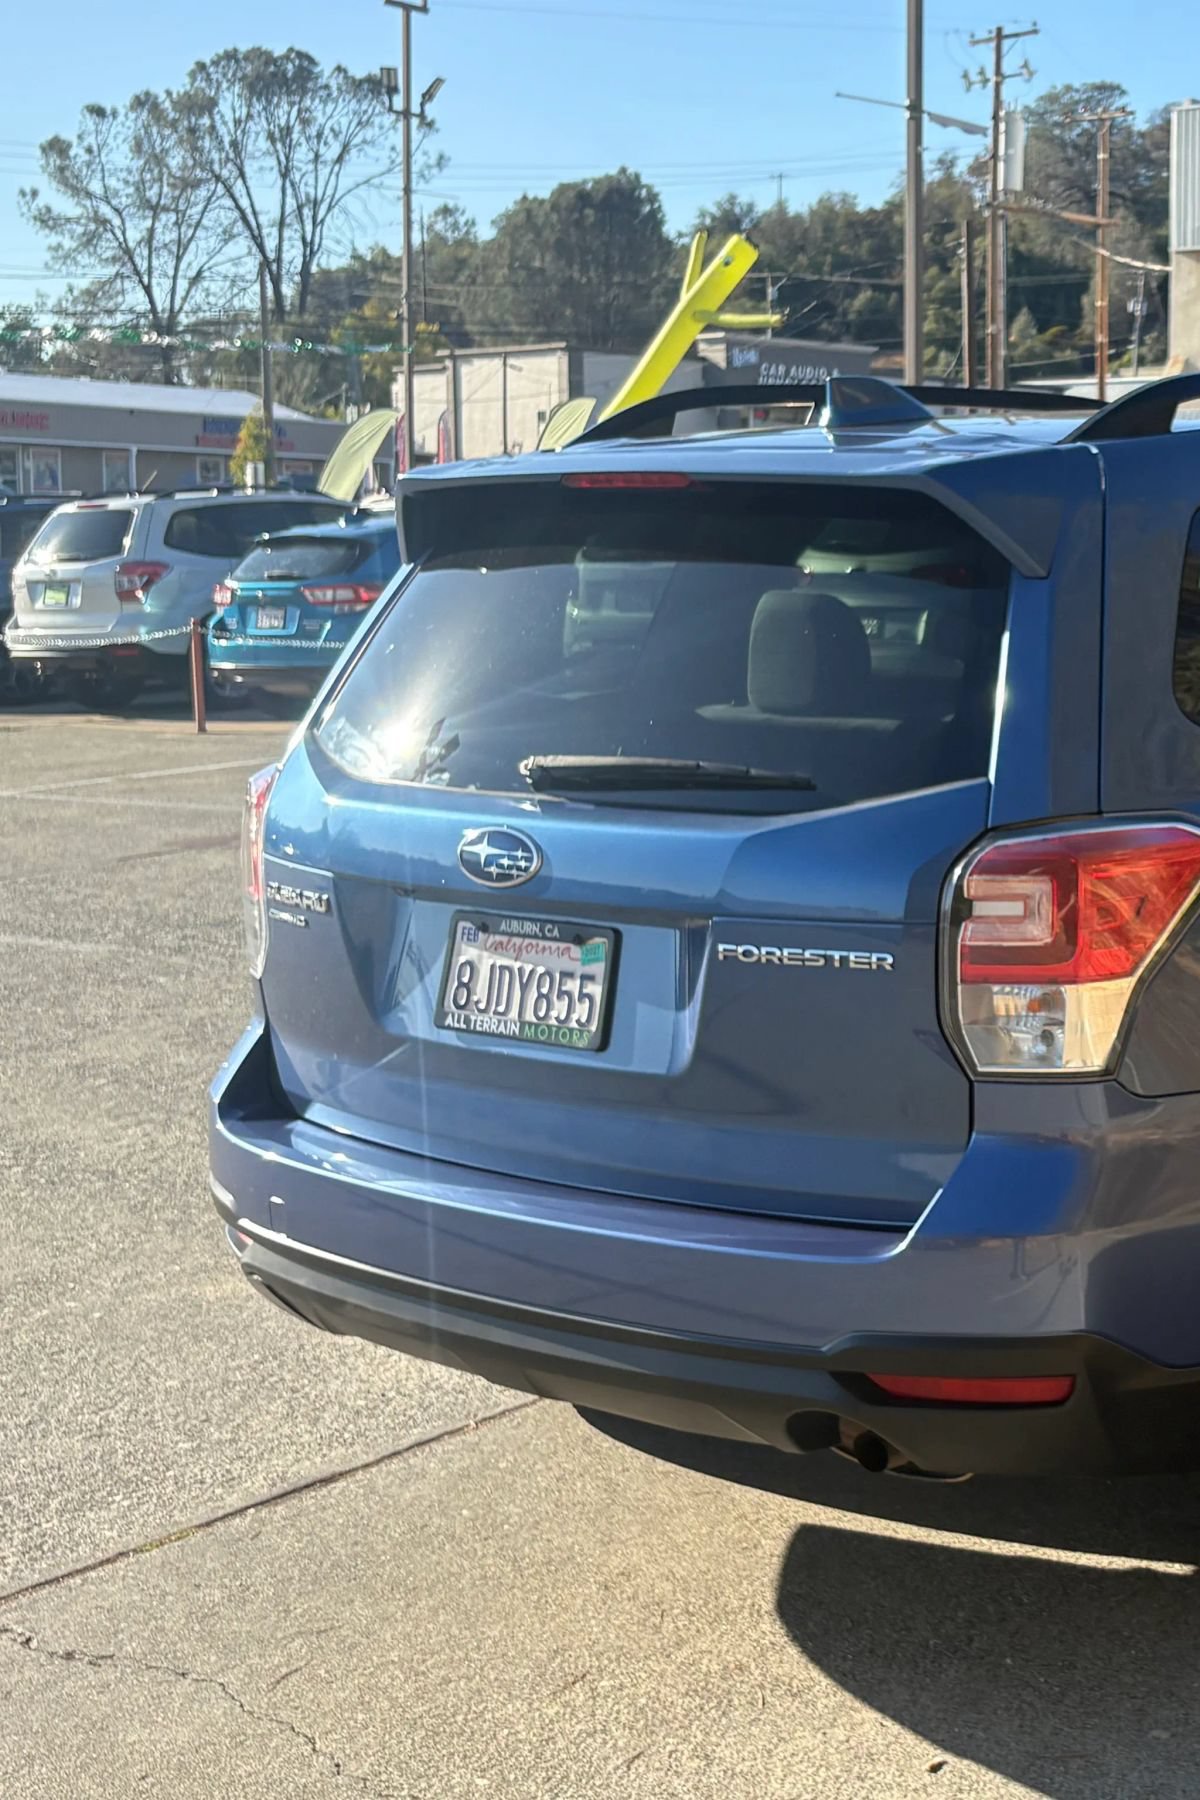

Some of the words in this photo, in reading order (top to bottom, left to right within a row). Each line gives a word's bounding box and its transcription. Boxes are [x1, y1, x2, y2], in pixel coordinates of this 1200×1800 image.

[760, 362, 786, 376] CAR
[790, 365, 828, 380] AUDIO
[461, 926, 479, 943] FEB
[500, 919, 543, 939] AUBURN,
[545, 924, 560, 939] CA
[484, 932, 580, 962] California
[717, 942, 894, 971] FORESTER
[452, 959, 596, 1028] 8JDY855
[445, 1013, 467, 1029] ALL
[470, 1016, 521, 1036] TERRAIN
[523, 1026, 591, 1046] MOTORS
